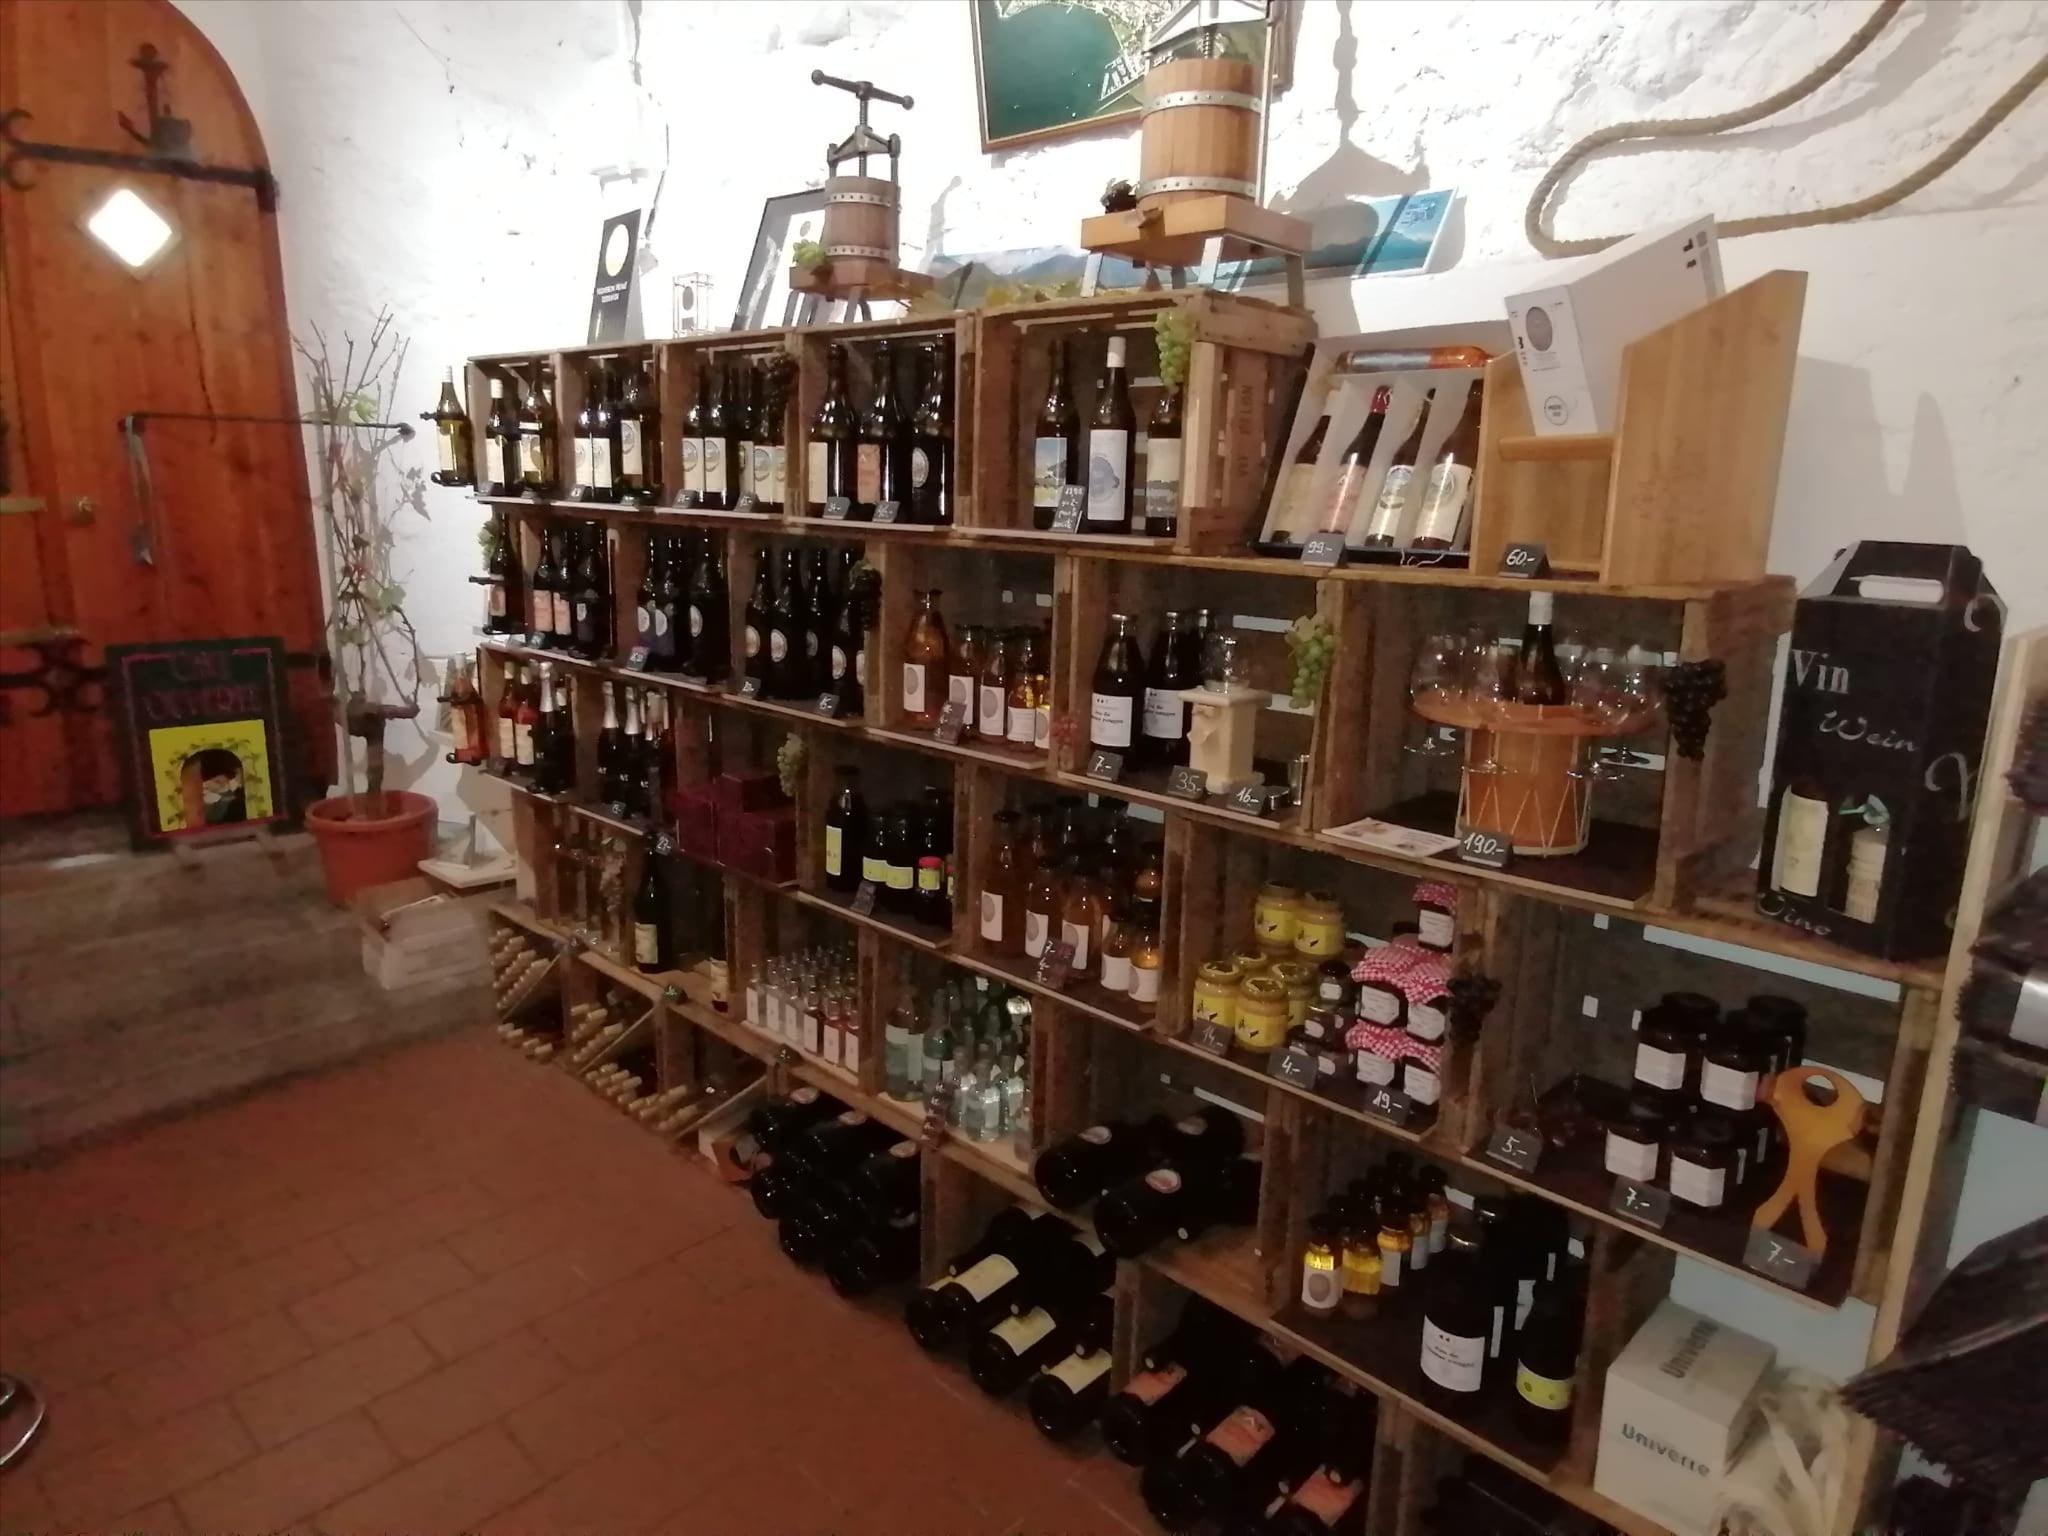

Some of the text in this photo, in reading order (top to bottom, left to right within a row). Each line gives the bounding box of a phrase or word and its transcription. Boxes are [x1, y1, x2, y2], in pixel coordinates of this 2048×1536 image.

[1791, 648, 1850, 695] Vin
[1818, 710, 1918, 752] Wein
[1621, 1422, 1711, 1478] Univerre
